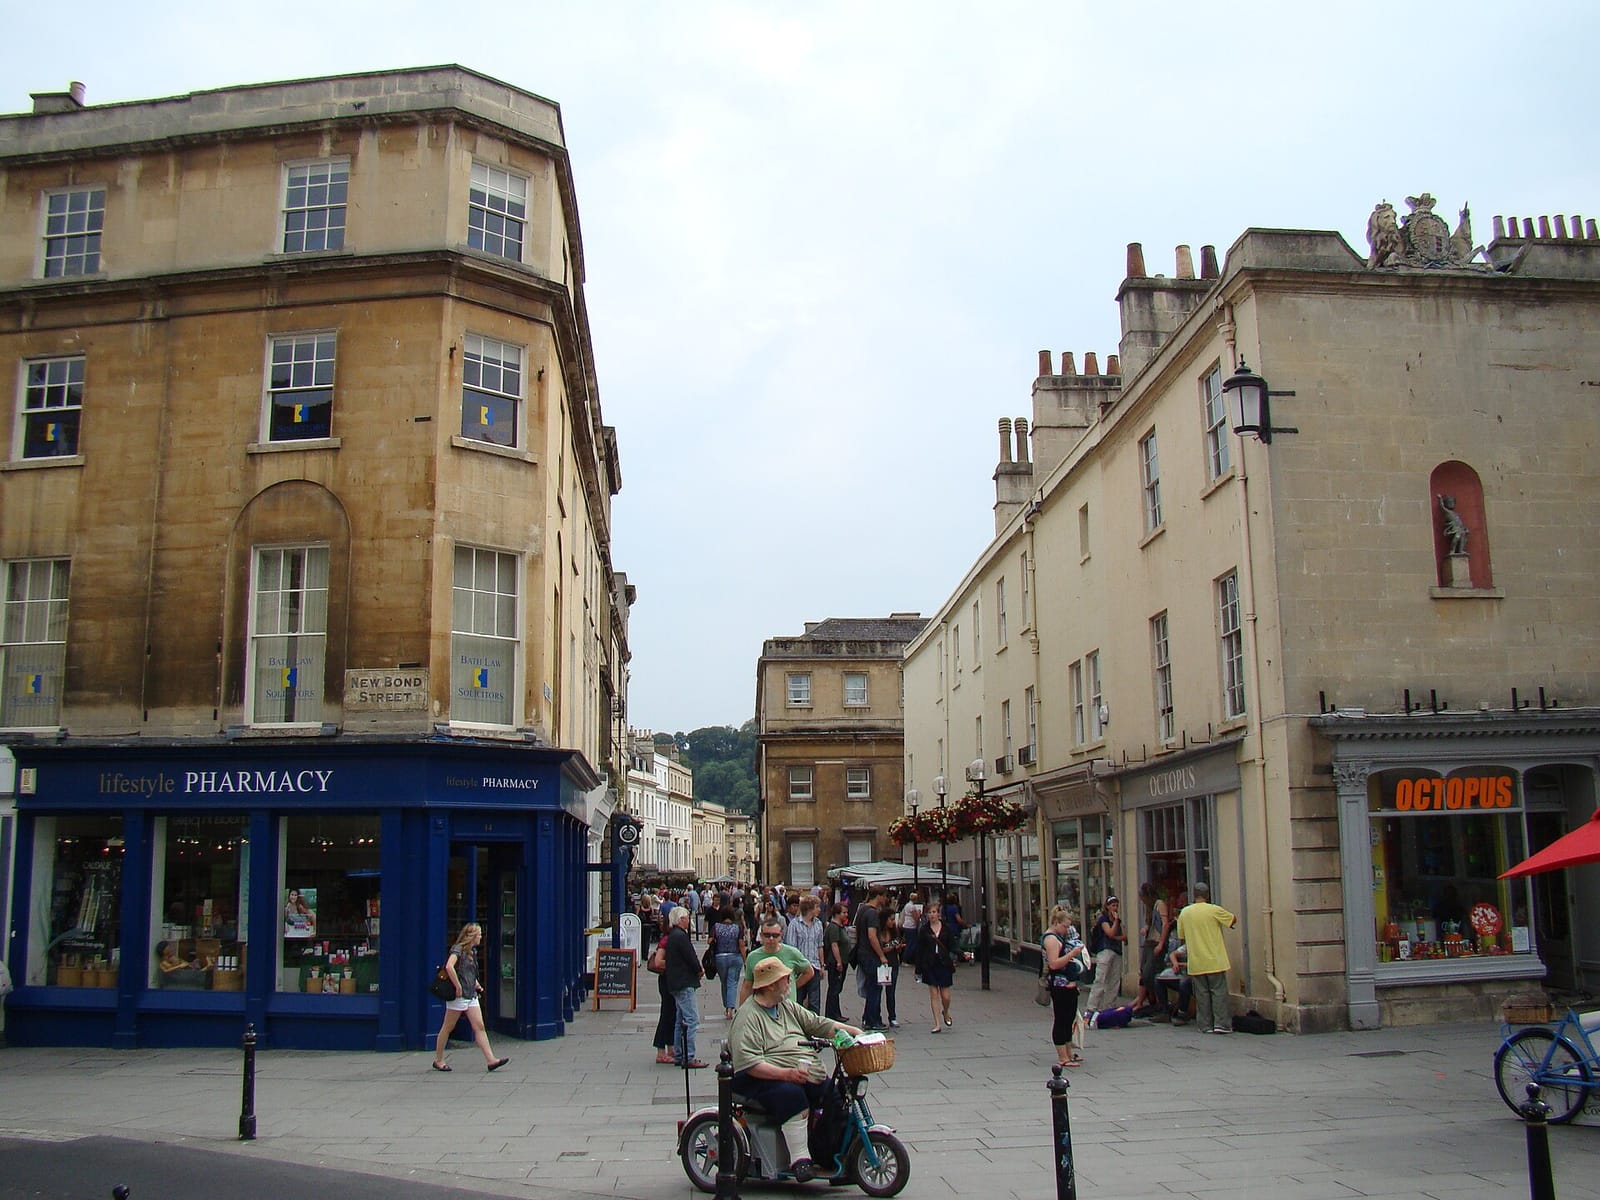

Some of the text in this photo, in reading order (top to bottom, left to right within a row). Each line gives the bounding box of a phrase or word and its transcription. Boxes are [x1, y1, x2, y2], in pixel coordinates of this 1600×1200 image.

[294, 656, 314, 666] LAW
[461, 655, 501, 668] BATH LAW
[351, 676, 422, 689] NEW BOND
[265, 688, 316, 698] SOLIORS
[359, 691, 412, 703] STREET
[457, 687, 505, 701] SOLICITORS
[99, 770, 334, 798] lifestyle PHARMACY
[482, 777, 539, 790] PHARMACY
[1150, 765, 1196, 797] OCTOPUS
[1395, 775, 1513, 811] OCTOPUS
